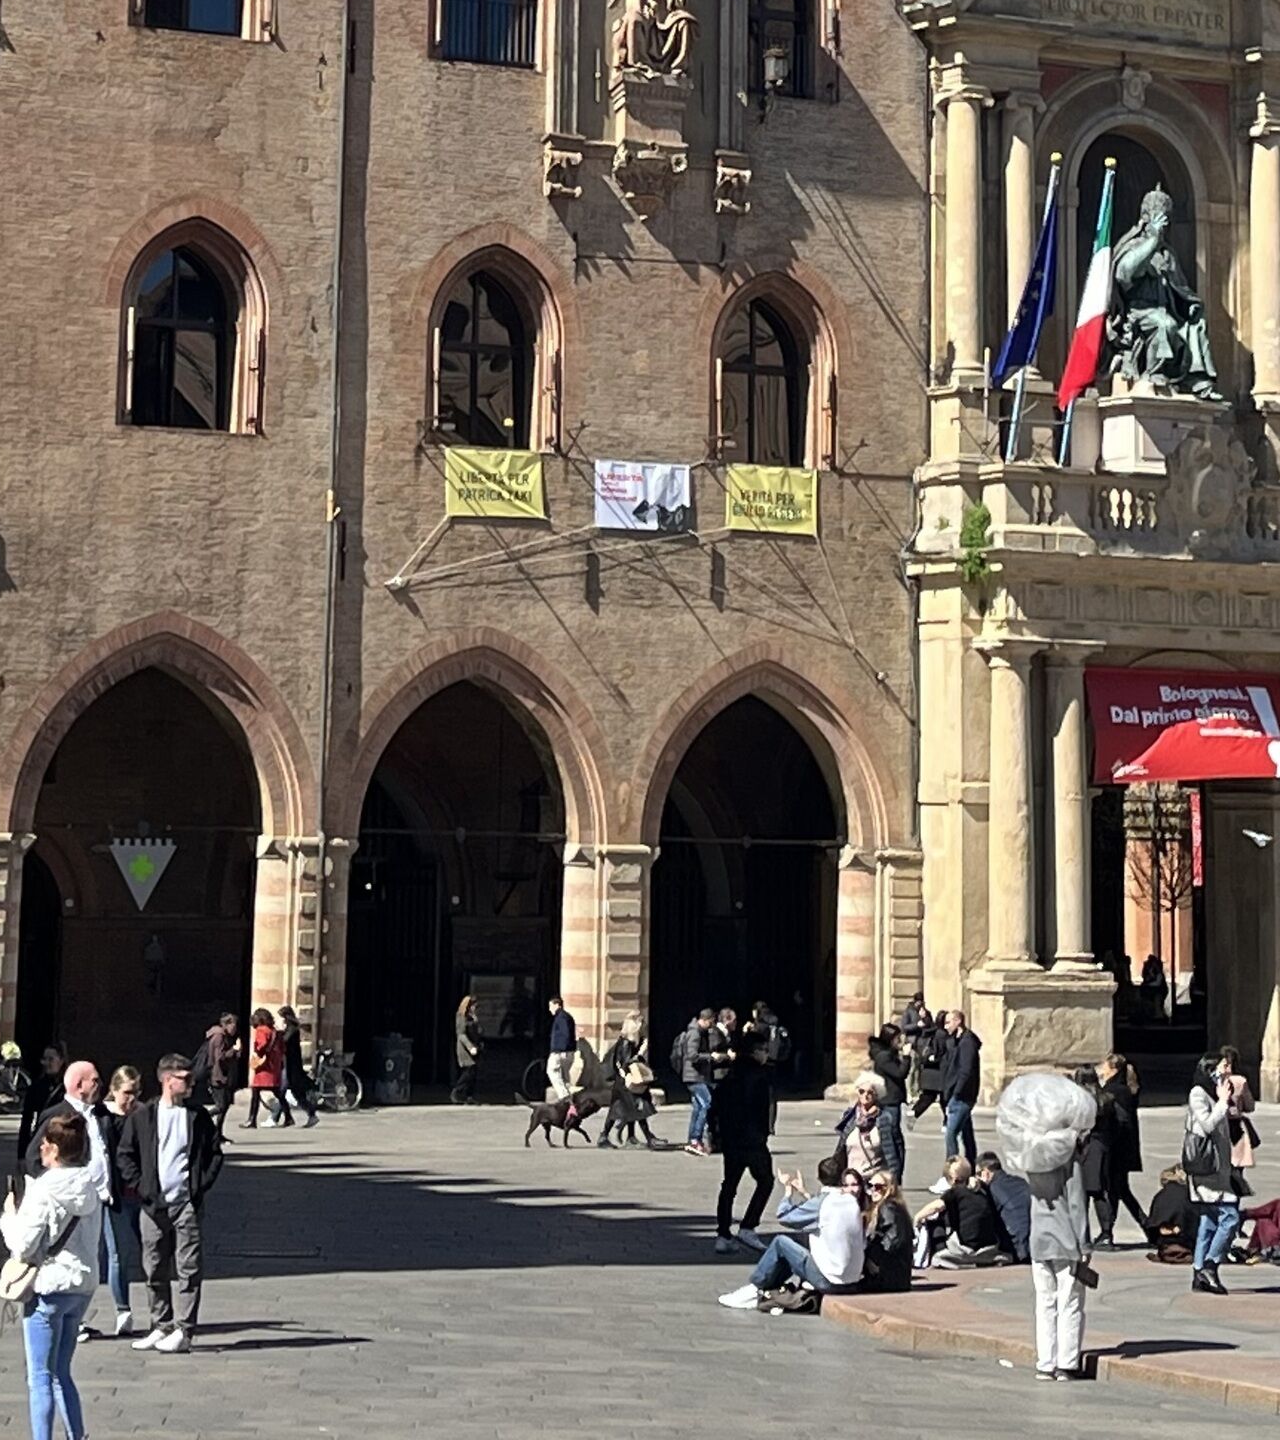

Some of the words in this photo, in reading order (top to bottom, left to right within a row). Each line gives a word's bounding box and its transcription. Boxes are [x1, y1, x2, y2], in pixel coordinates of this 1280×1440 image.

[775, 491, 795, 507] PER
[1110, 705, 1138, 724] Dal
[1141, 706, 1192, 728] primo
